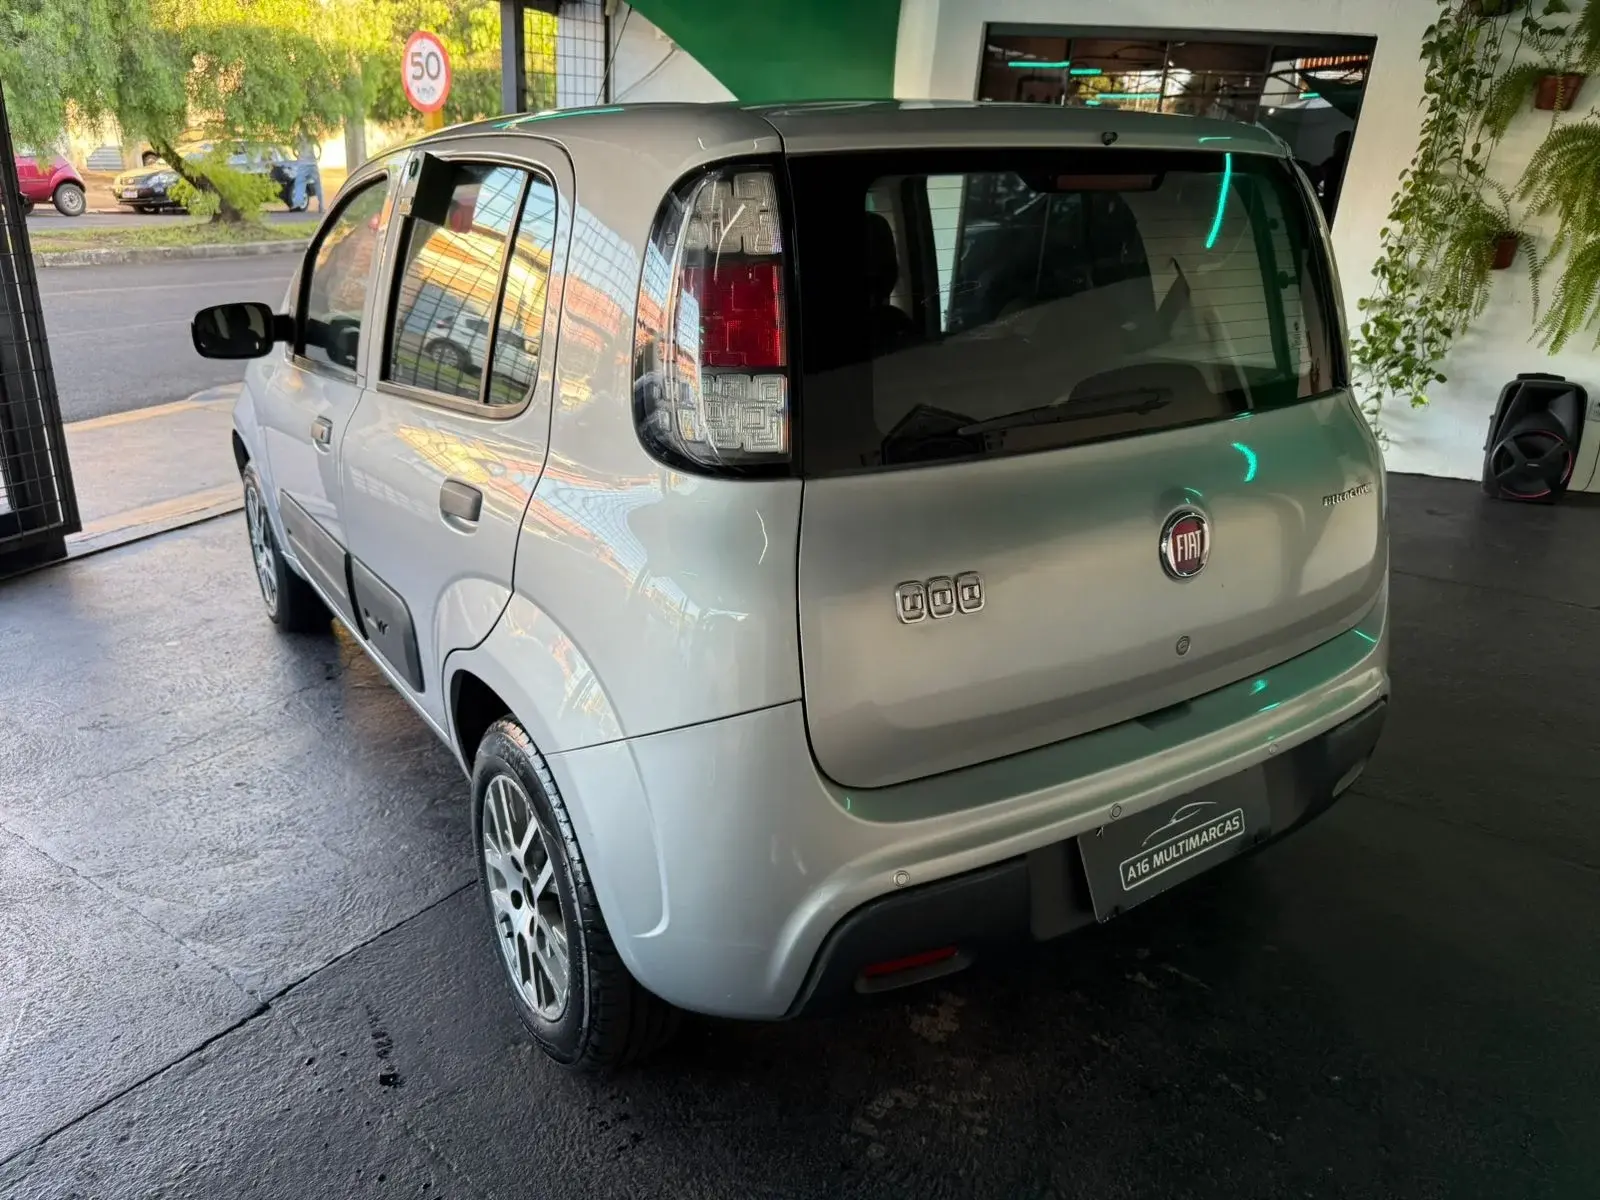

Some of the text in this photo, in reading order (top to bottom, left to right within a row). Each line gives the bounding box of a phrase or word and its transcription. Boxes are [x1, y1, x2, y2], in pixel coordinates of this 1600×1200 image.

[410, 51, 441, 81] 50
[1176, 529, 1202, 562] FIAT
[1126, 815, 1240, 882] A16 MULTIMARCAS
